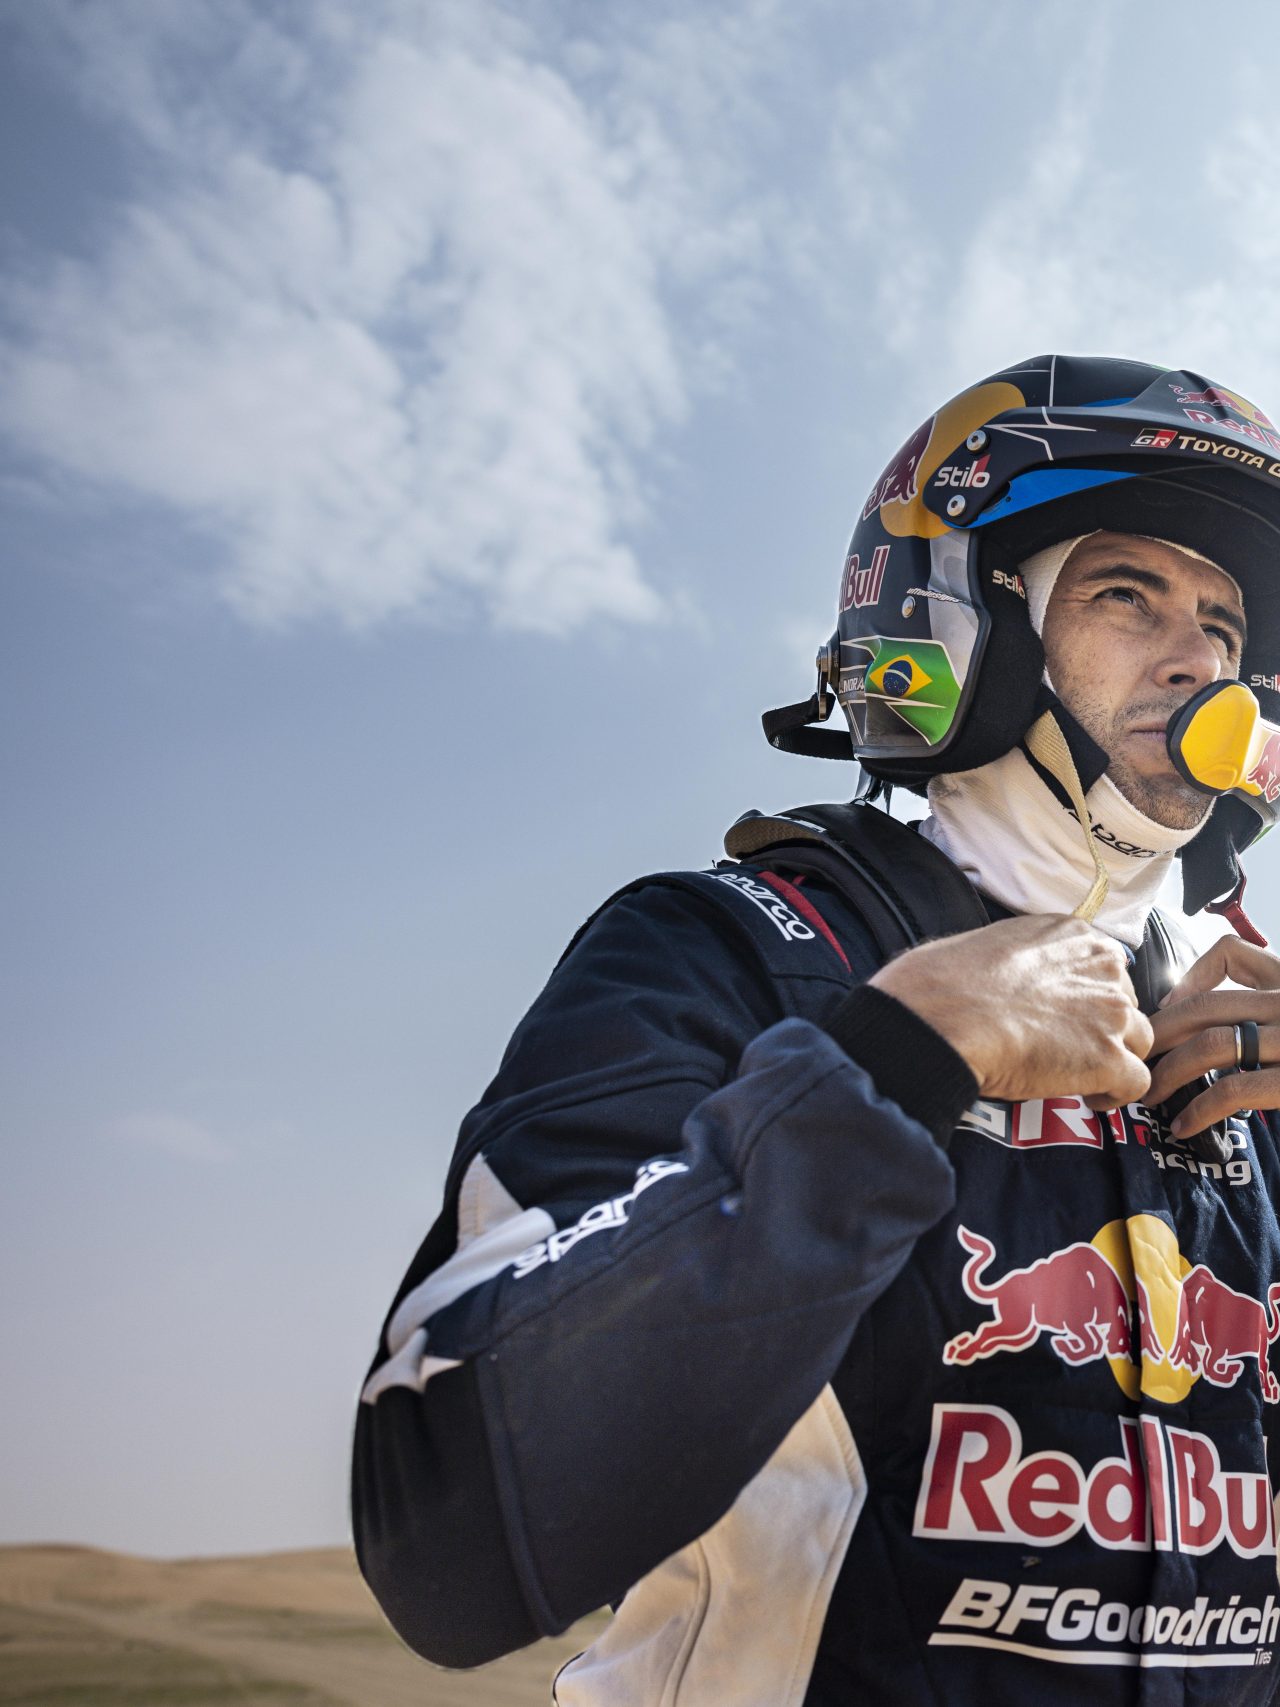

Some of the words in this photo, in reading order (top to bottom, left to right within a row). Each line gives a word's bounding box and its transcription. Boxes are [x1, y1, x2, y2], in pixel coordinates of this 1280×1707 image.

[1178, 435, 1265, 469] TOYOTA
[934, 458, 991, 488] Stilo
[913, 1402, 1167, 1552] Red
[1166, 1425, 1278, 1559] Bu
